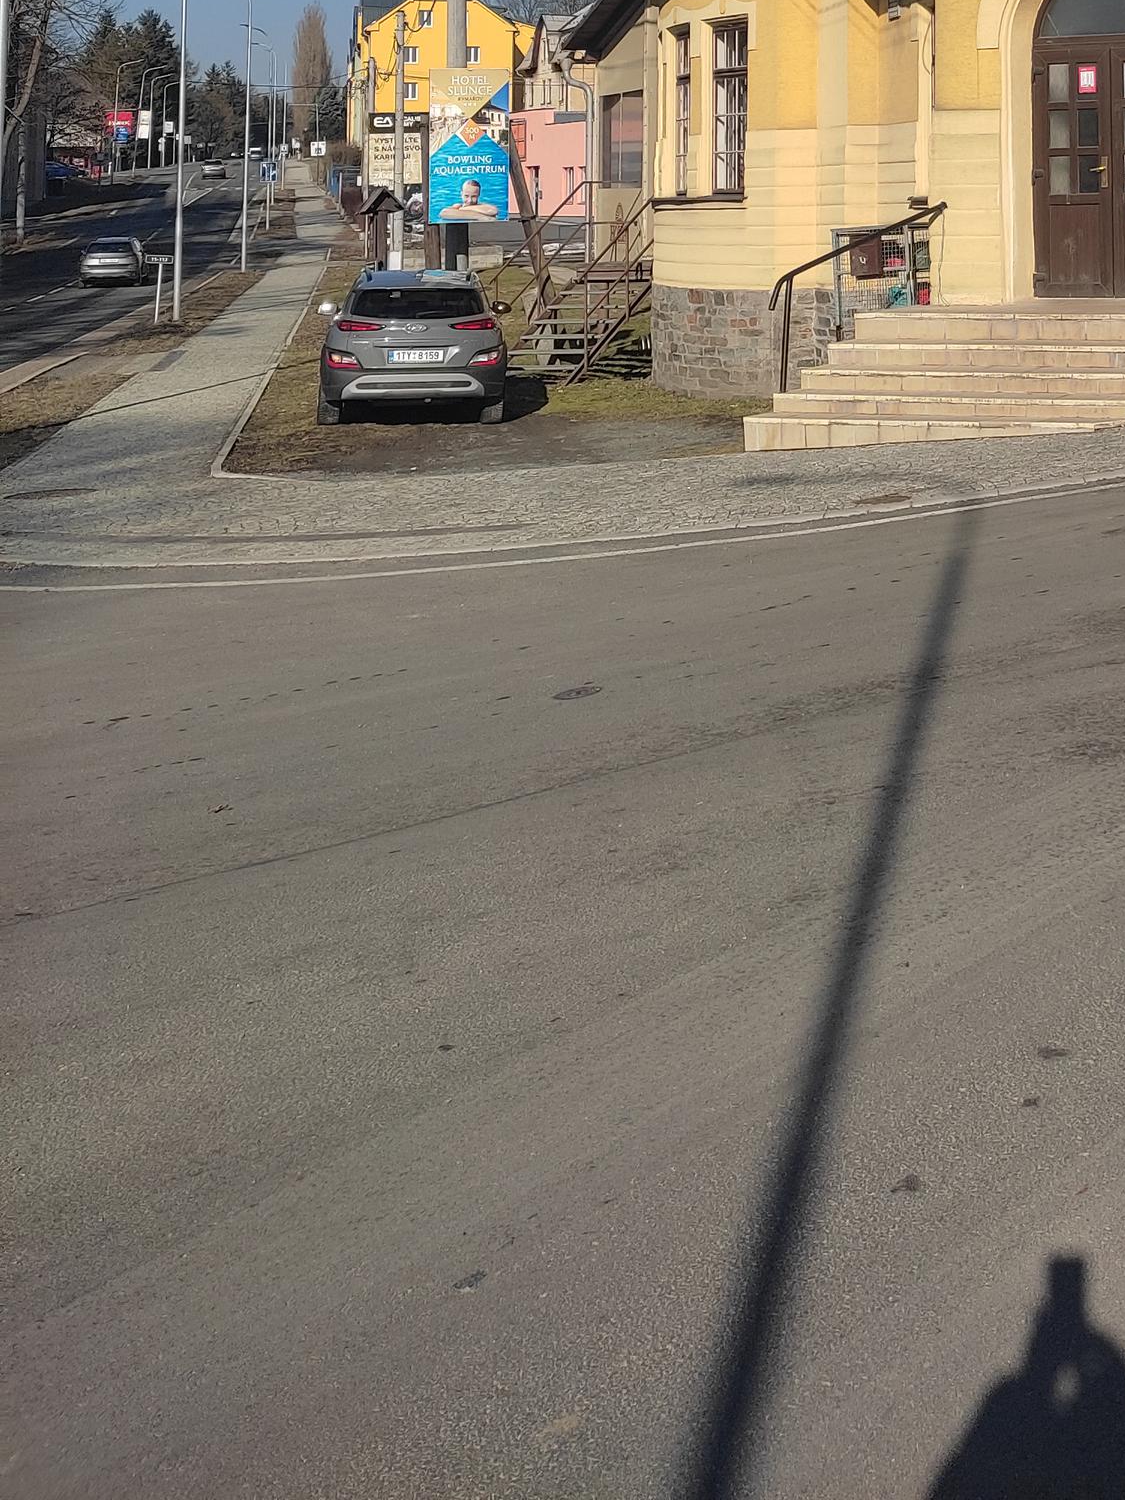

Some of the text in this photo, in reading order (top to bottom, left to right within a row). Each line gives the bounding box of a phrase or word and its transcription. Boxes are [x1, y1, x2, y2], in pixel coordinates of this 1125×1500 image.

[451, 75, 490, 85] HOTEL
[447, 85, 493, 96] SLUNCE
[447, 155, 493, 164] BOWLING
[433, 165, 506, 175] AQUACENTRUM
[396, 351, 440, 360] 1TY 8159
